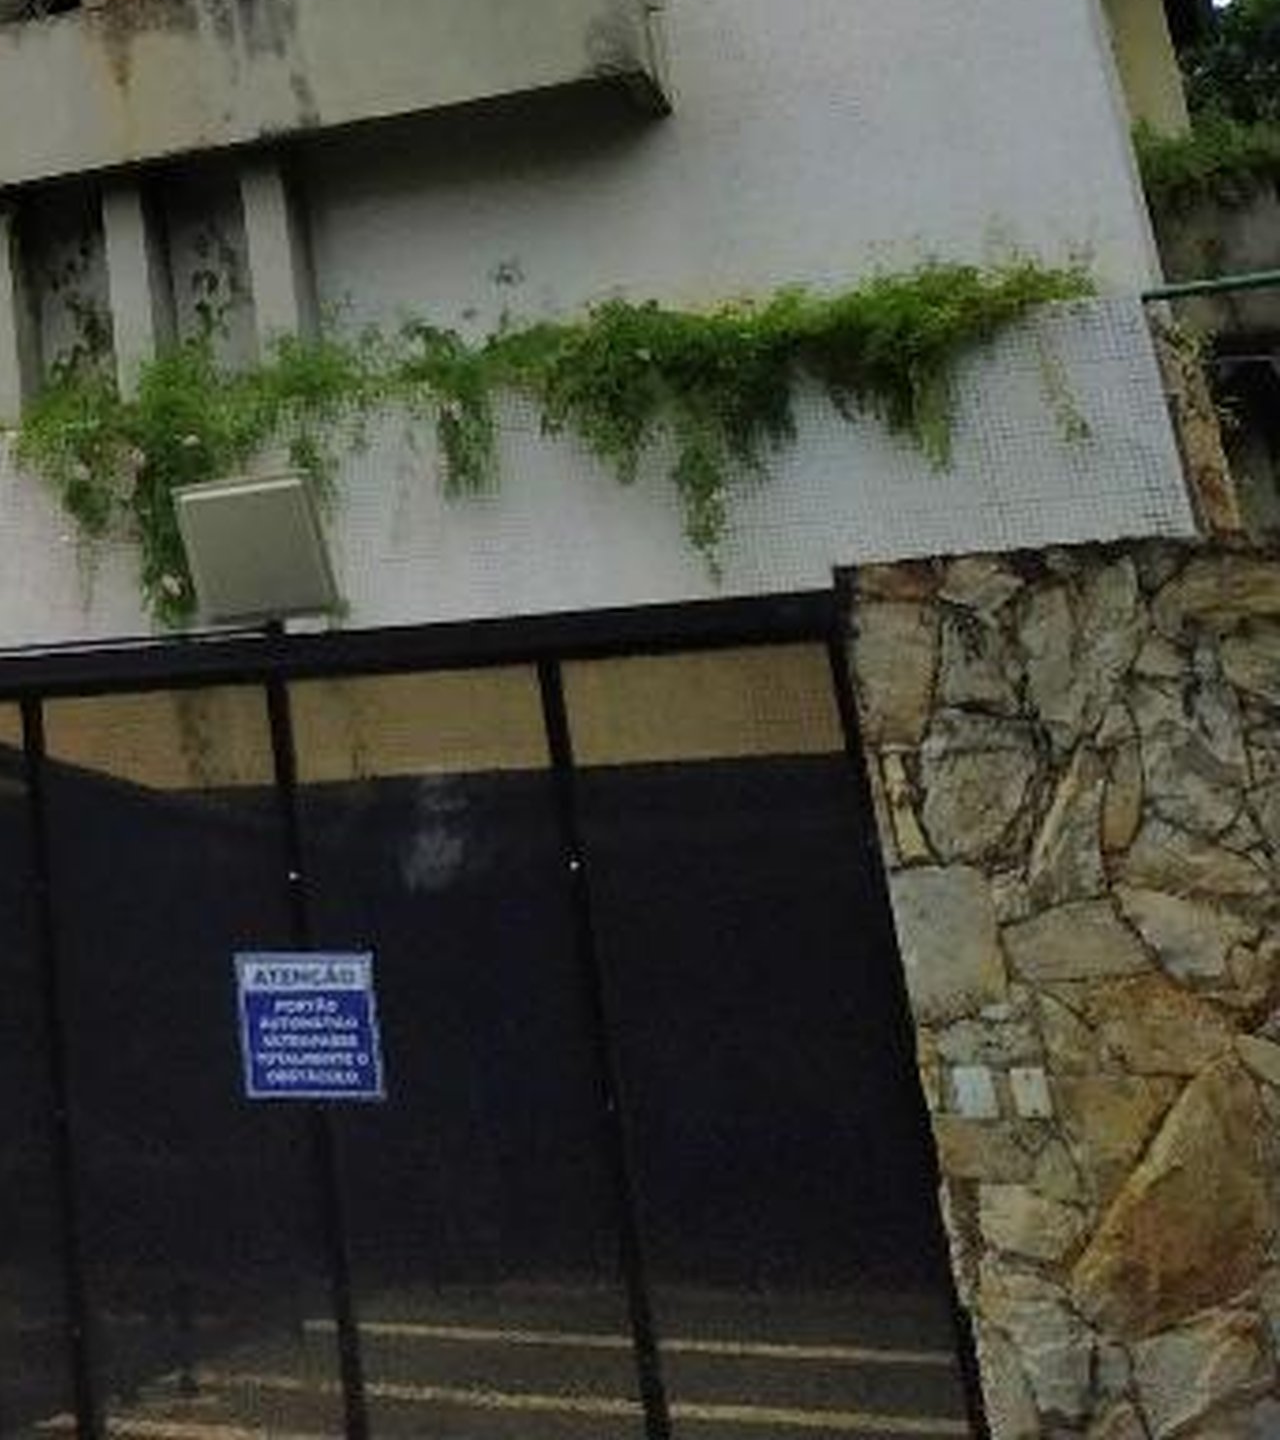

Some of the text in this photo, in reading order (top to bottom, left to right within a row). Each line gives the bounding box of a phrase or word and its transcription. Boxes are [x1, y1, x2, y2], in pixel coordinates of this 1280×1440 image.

[253, 964, 356, 986] ATENÇÃO
[274, 997, 338, 1013] PORTÃO
[356, 1053, 370, 1066] O
